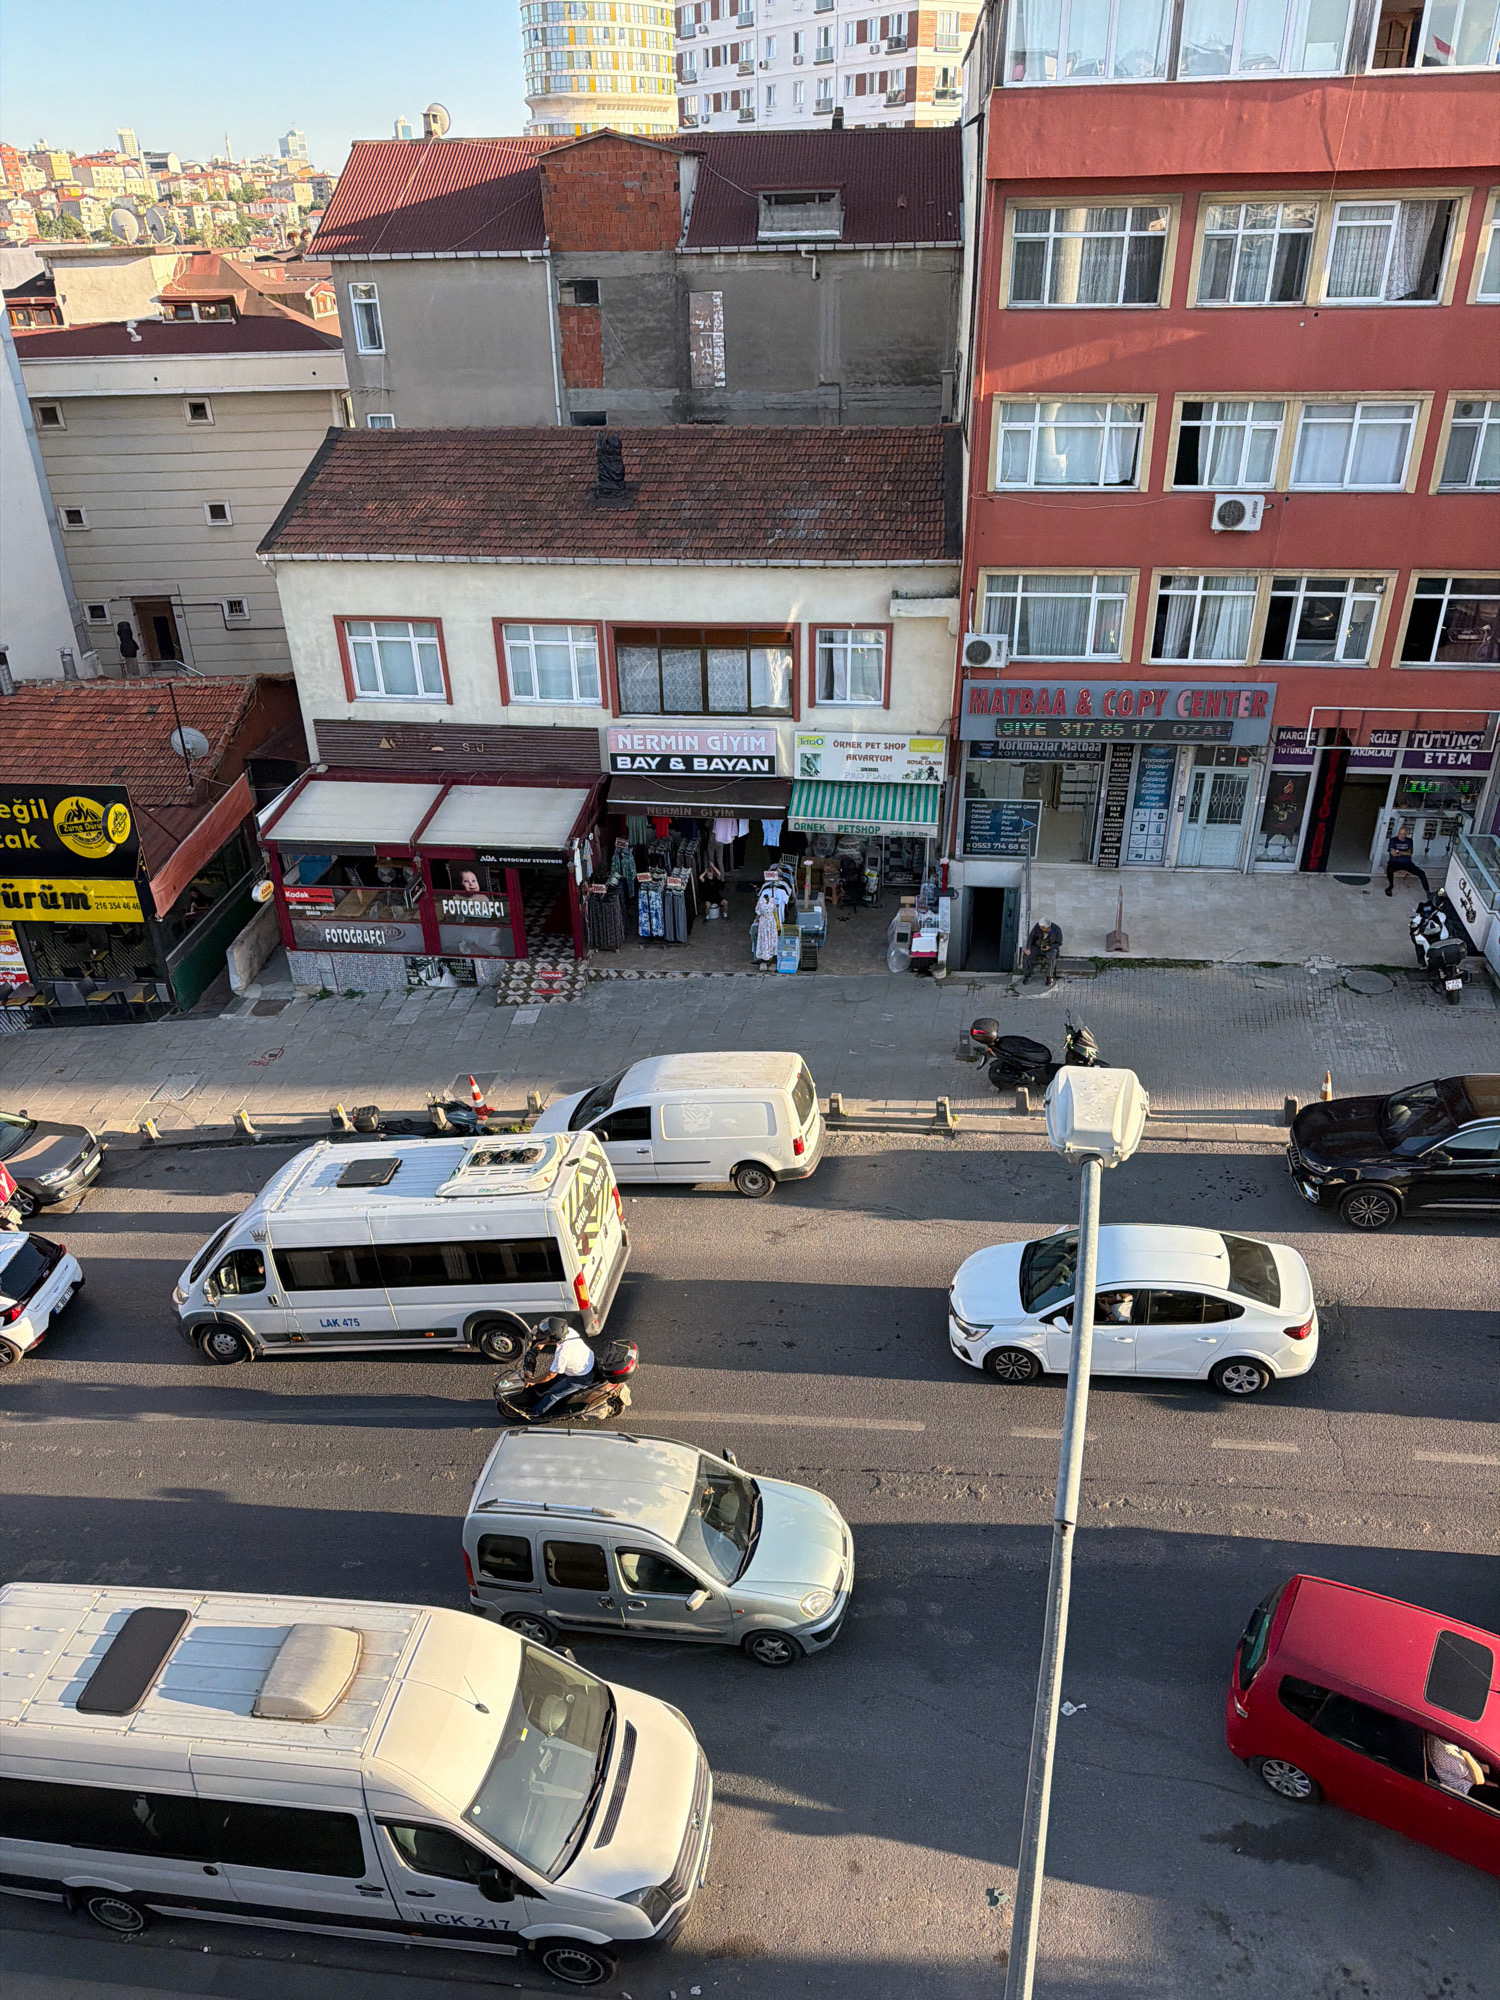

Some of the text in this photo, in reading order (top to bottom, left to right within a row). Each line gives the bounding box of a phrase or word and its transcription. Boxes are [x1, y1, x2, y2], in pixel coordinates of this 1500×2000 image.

[968, 687, 1269, 718] MATBAA & COPY CENTER
[617, 732, 766, 753] NERMİN GİYİM
[832, 739, 863, 749] ÖRNEK
[865, 741, 882, 750] PET
[883, 742, 907, 751] SHOP
[616, 756, 770, 772] BAY & BAYAN
[845, 753, 893, 763] AKVARYUM
[1424, 752, 1473, 765] ETEM
[647, 806, 735, 818] NERMİN GİYİM
[84, 821, 102, 831] Dürü
[837, 824, 881, 835] PETSHOP
[94, 902, 108, 910] 216
[108, 902, 121, 910] 354
[122, 902, 131, 911] 46
[325, 926, 386, 946] FOTOĞRAFÇI
[319, 1318, 361, 1328] LAK 475
[419, 1912, 511, 1930] LCK 217
